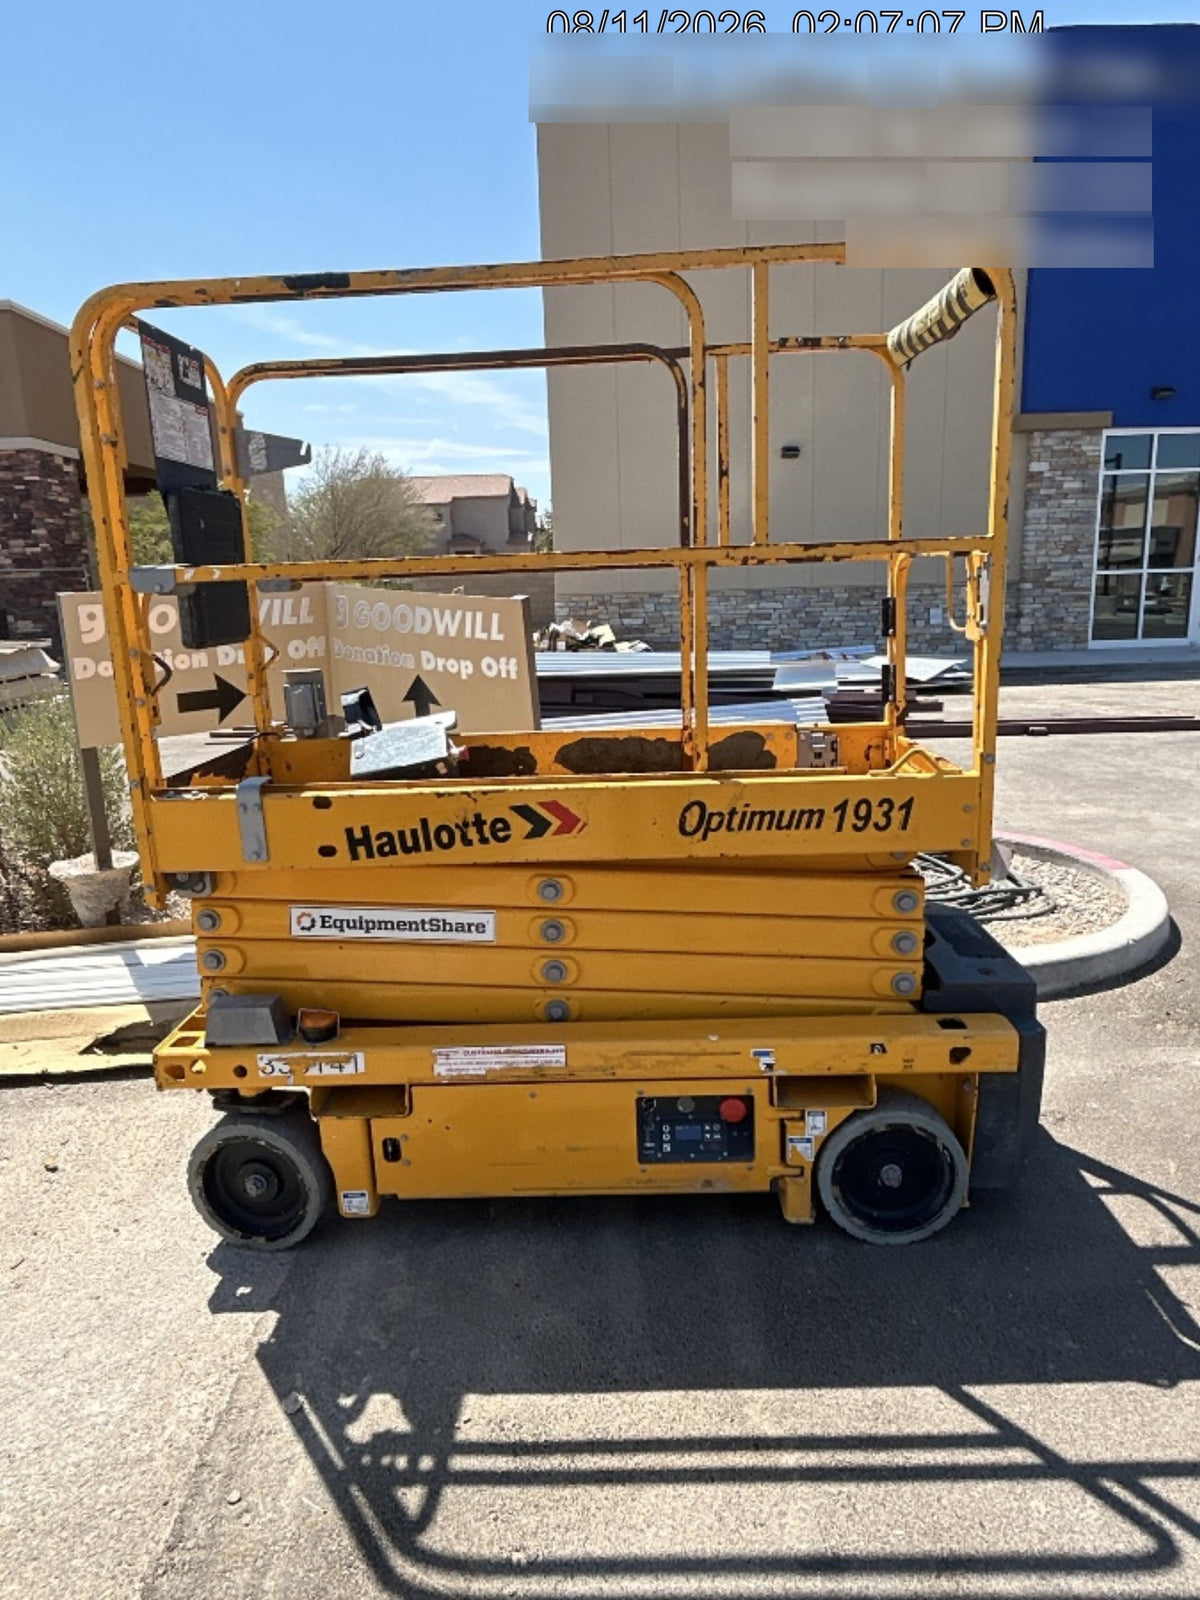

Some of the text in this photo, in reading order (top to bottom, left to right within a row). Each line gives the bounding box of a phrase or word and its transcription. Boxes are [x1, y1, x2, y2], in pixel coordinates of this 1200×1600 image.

[353, 600, 506, 641] GOODWILL
[287, 635, 326, 660] Off
[333, 637, 519, 680] Donation Drop Off
[344, 812, 512, 861] Haulotte
[678, 796, 915, 842] Optimum 1931
[319, 914, 487, 934] EquipmentShare
